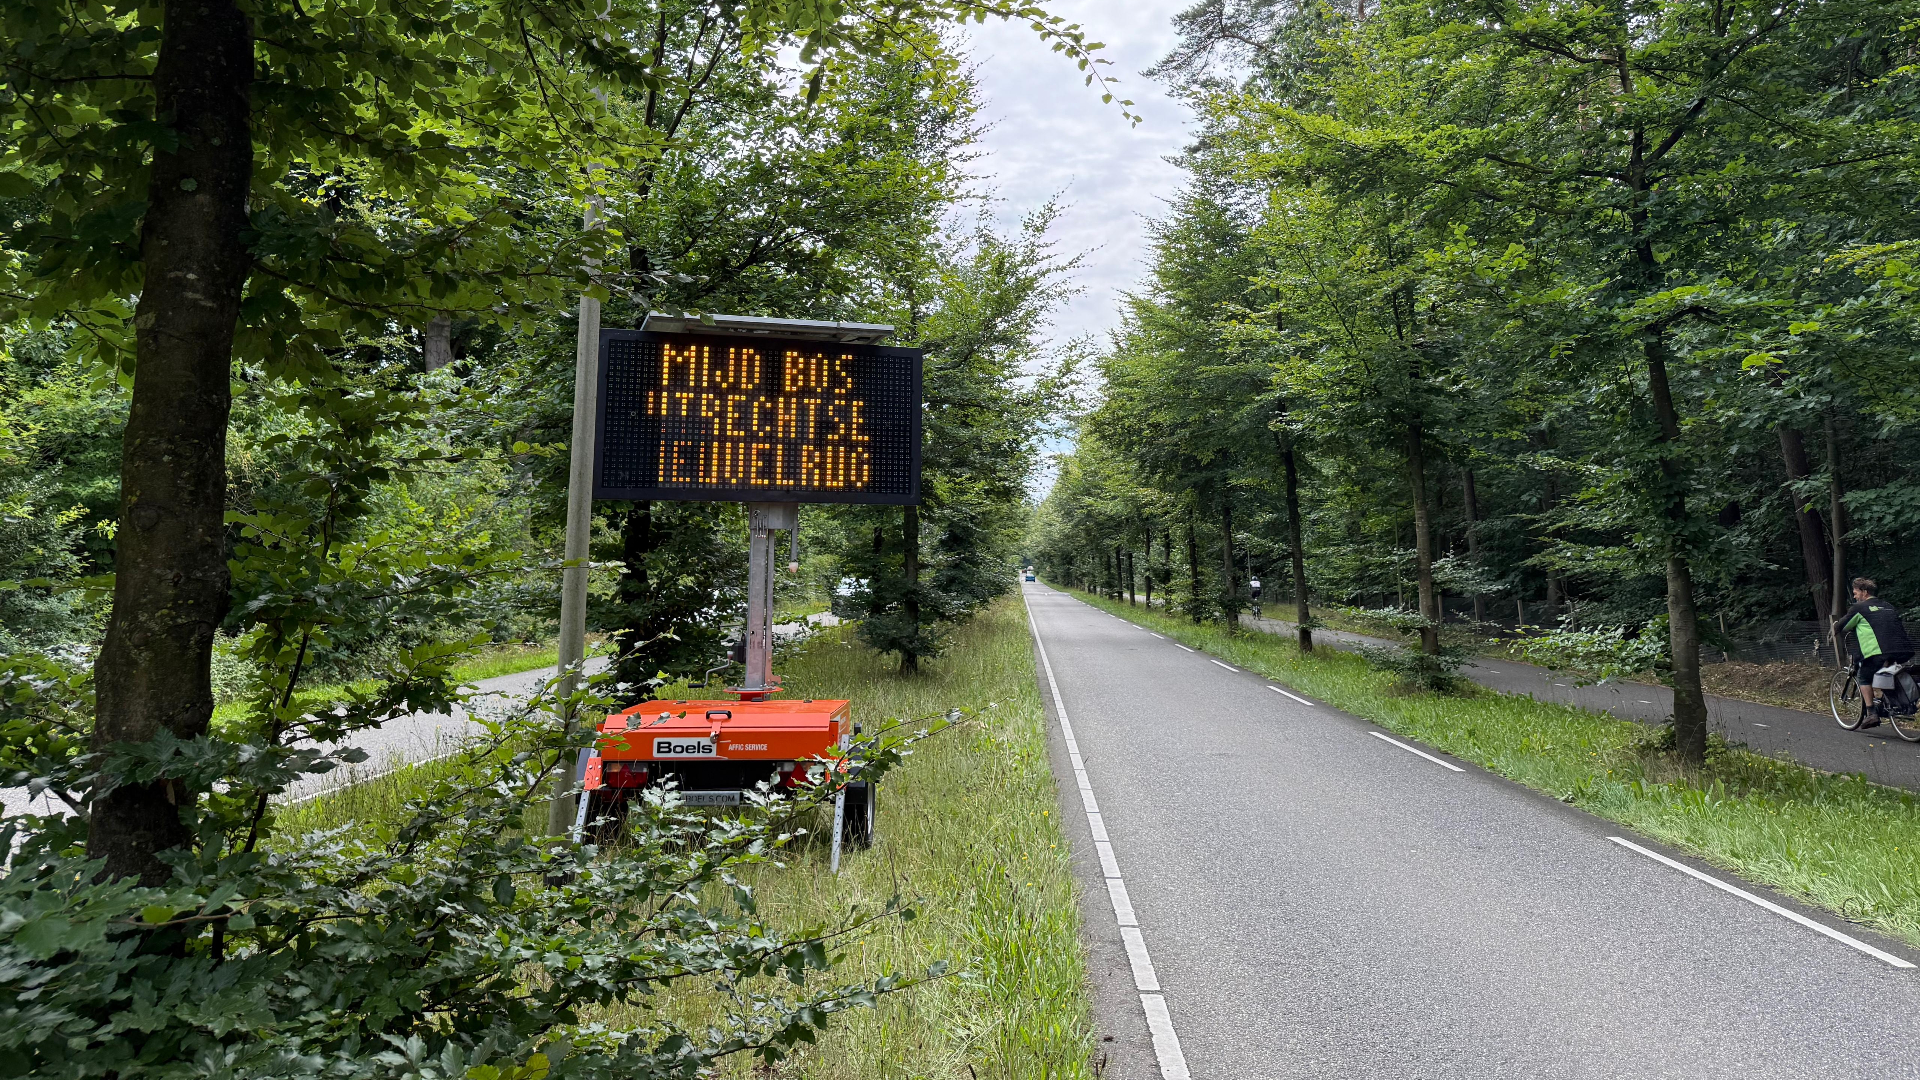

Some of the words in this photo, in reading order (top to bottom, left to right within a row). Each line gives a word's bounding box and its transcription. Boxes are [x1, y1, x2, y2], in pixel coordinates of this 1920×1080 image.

[661, 343, 761, 389] MIJD
[785, 350, 853, 393] BOS
[656, 741, 713, 754] Boels
[744, 743, 768, 751] SERVICE
